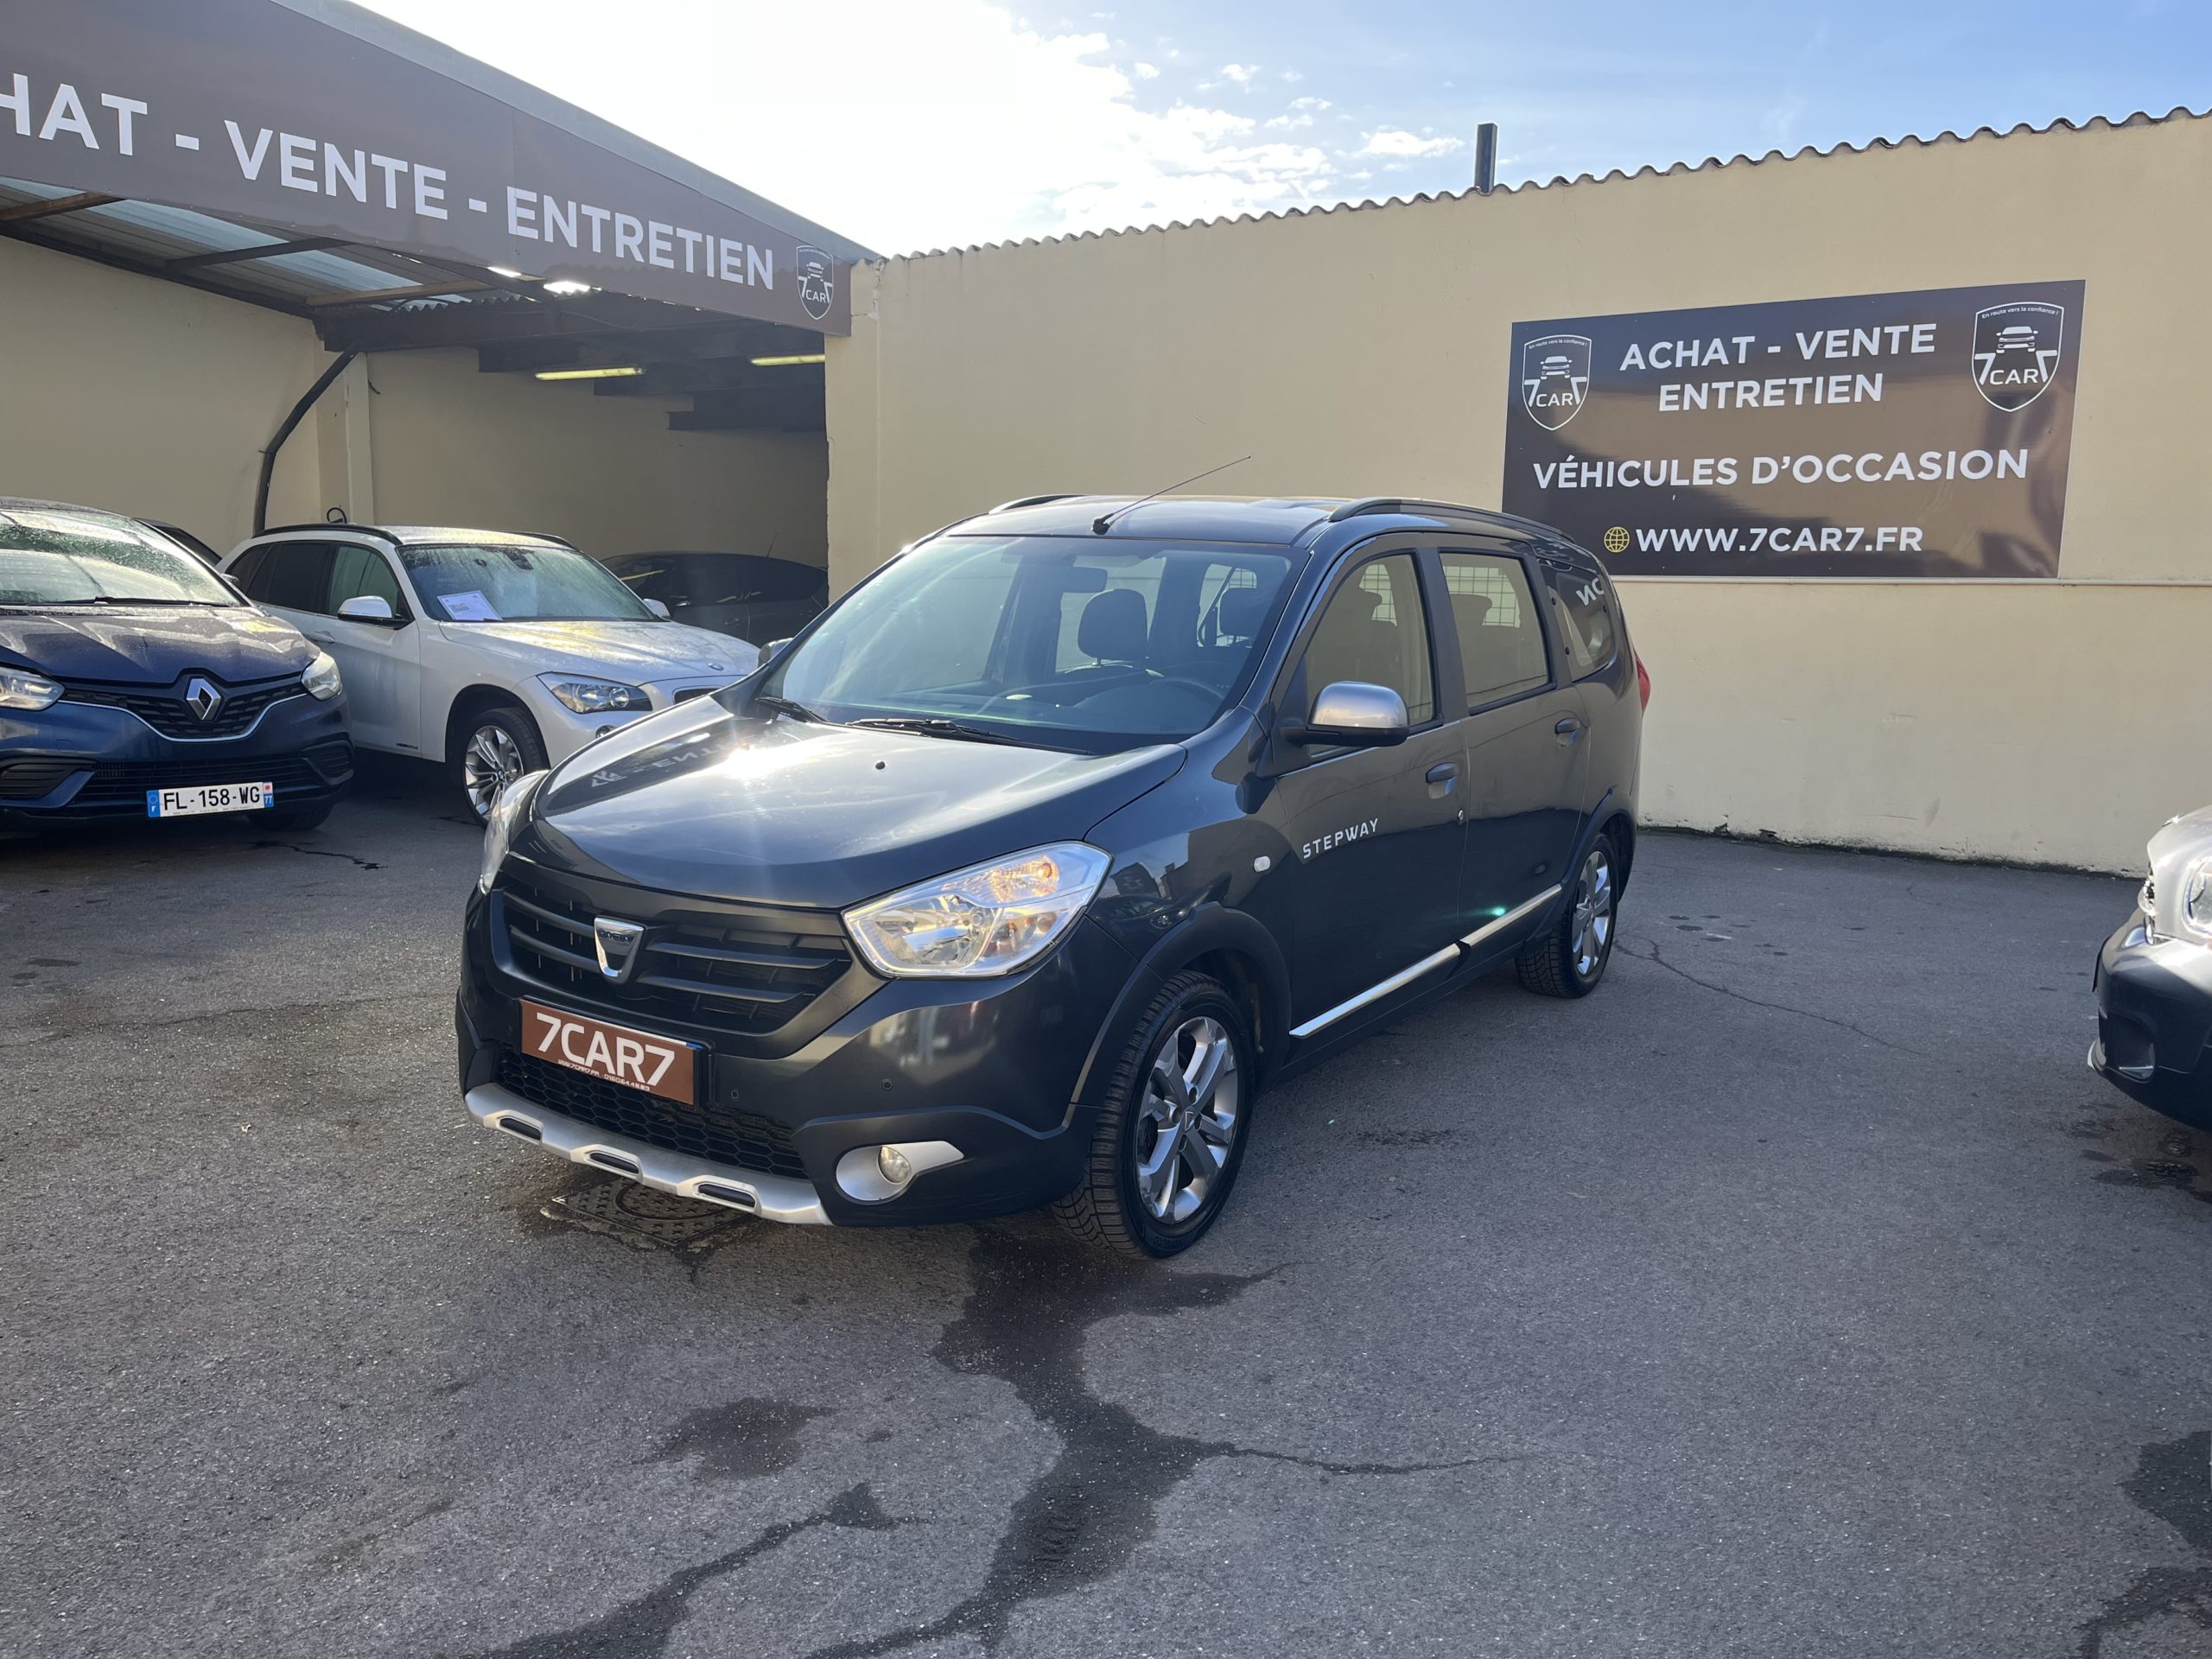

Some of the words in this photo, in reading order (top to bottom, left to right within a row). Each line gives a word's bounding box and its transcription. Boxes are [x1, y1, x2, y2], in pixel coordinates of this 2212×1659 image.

[224, 119, 448, 220] VENTE
[506, 186, 774, 291] ENTRETIEN
[2027, 306, 2056, 315] confiance
[1619, 335, 1756, 372] ACHAT
[1796, 322, 1937, 360] VENTE
[1658, 372, 1884, 412] ENTRETIEN
[1533, 454, 1738, 489] VÉHICULES
[1636, 525, 1923, 552] WWW.7CAR7.FR
[264, 795, 273, 805] 77
[1303, 817, 1378, 859] STEPWAY
[537, 1012, 675, 1086] 7CAR7
